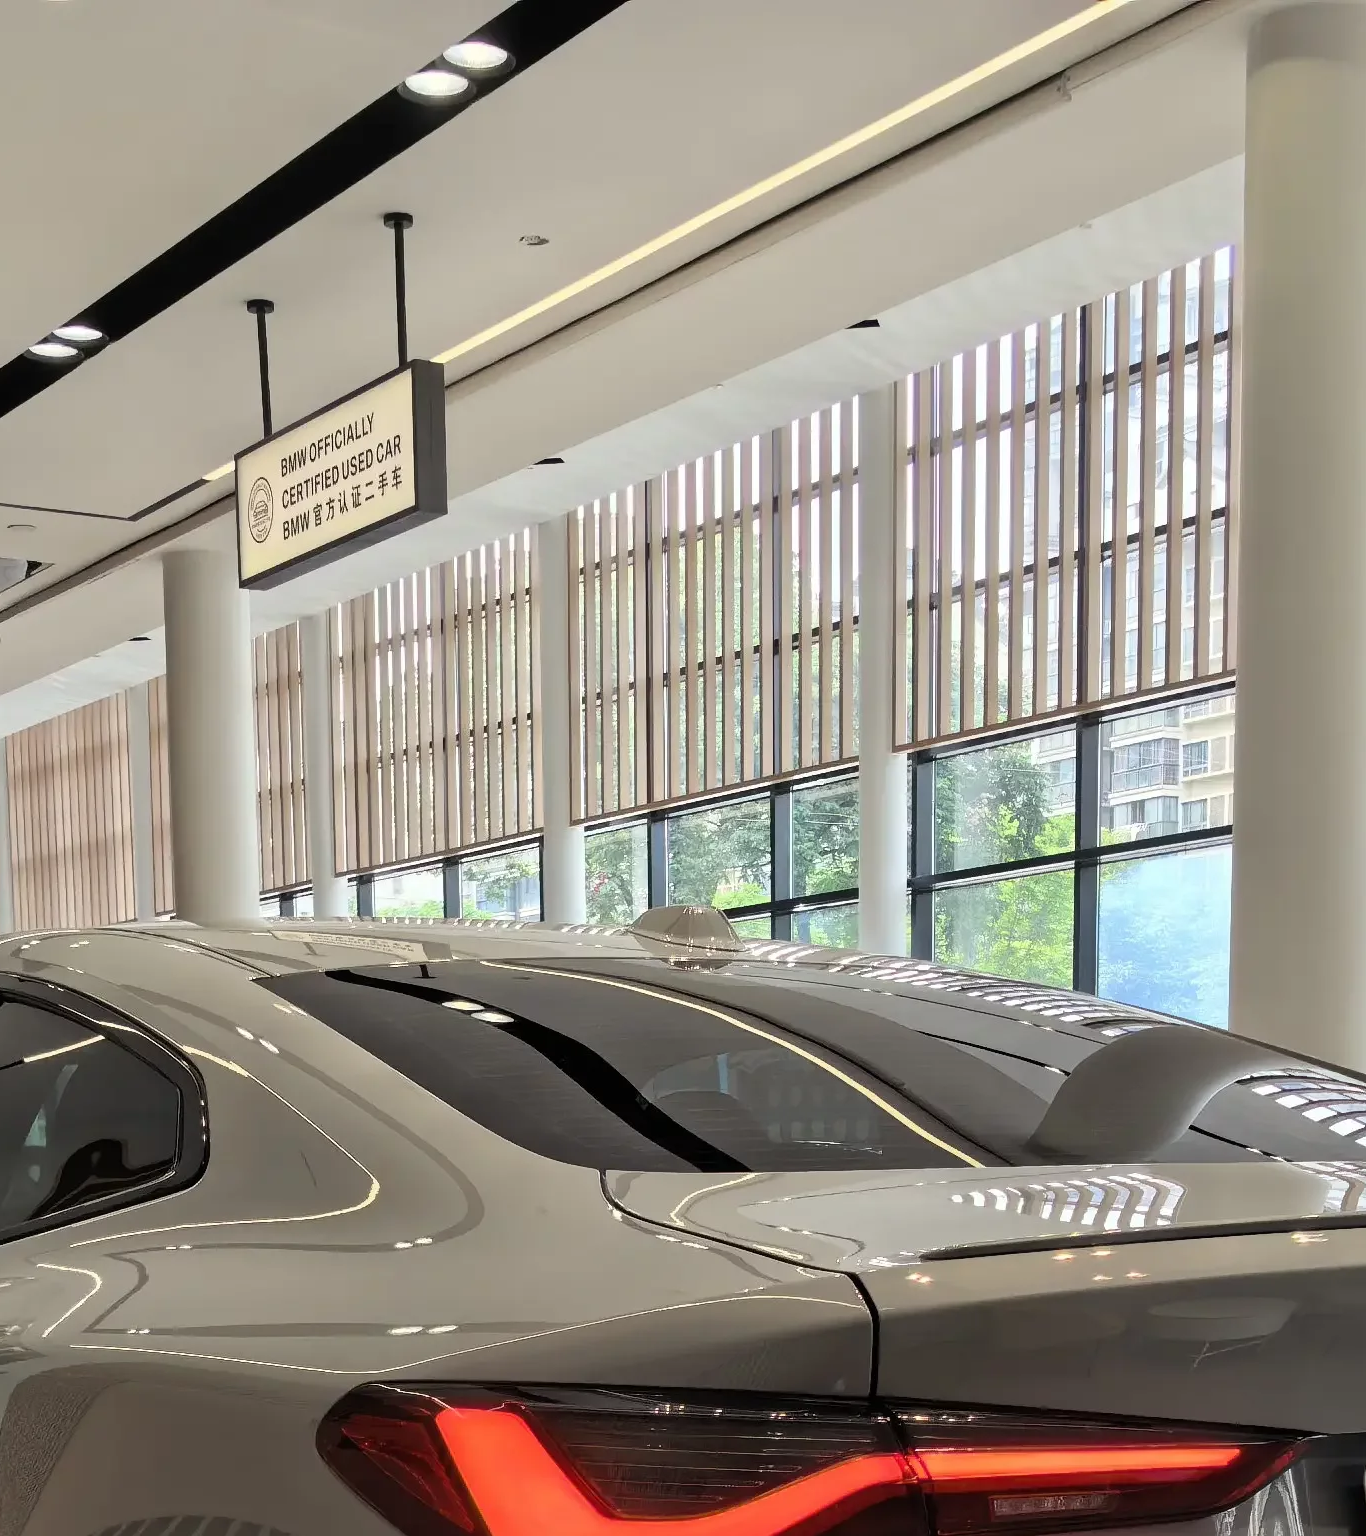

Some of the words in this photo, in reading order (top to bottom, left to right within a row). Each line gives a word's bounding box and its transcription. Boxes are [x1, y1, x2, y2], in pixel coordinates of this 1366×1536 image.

[280, 445, 308, 478] BMW
[309, 412, 375, 463] OFFICIALLY
[282, 465, 339, 509] CERTIFIED
[341, 449, 373, 480] USED
[376, 434, 402, 464] CAR
[282, 510, 310, 540] BMW
[312, 466, 403, 527] 官方认证二手车
